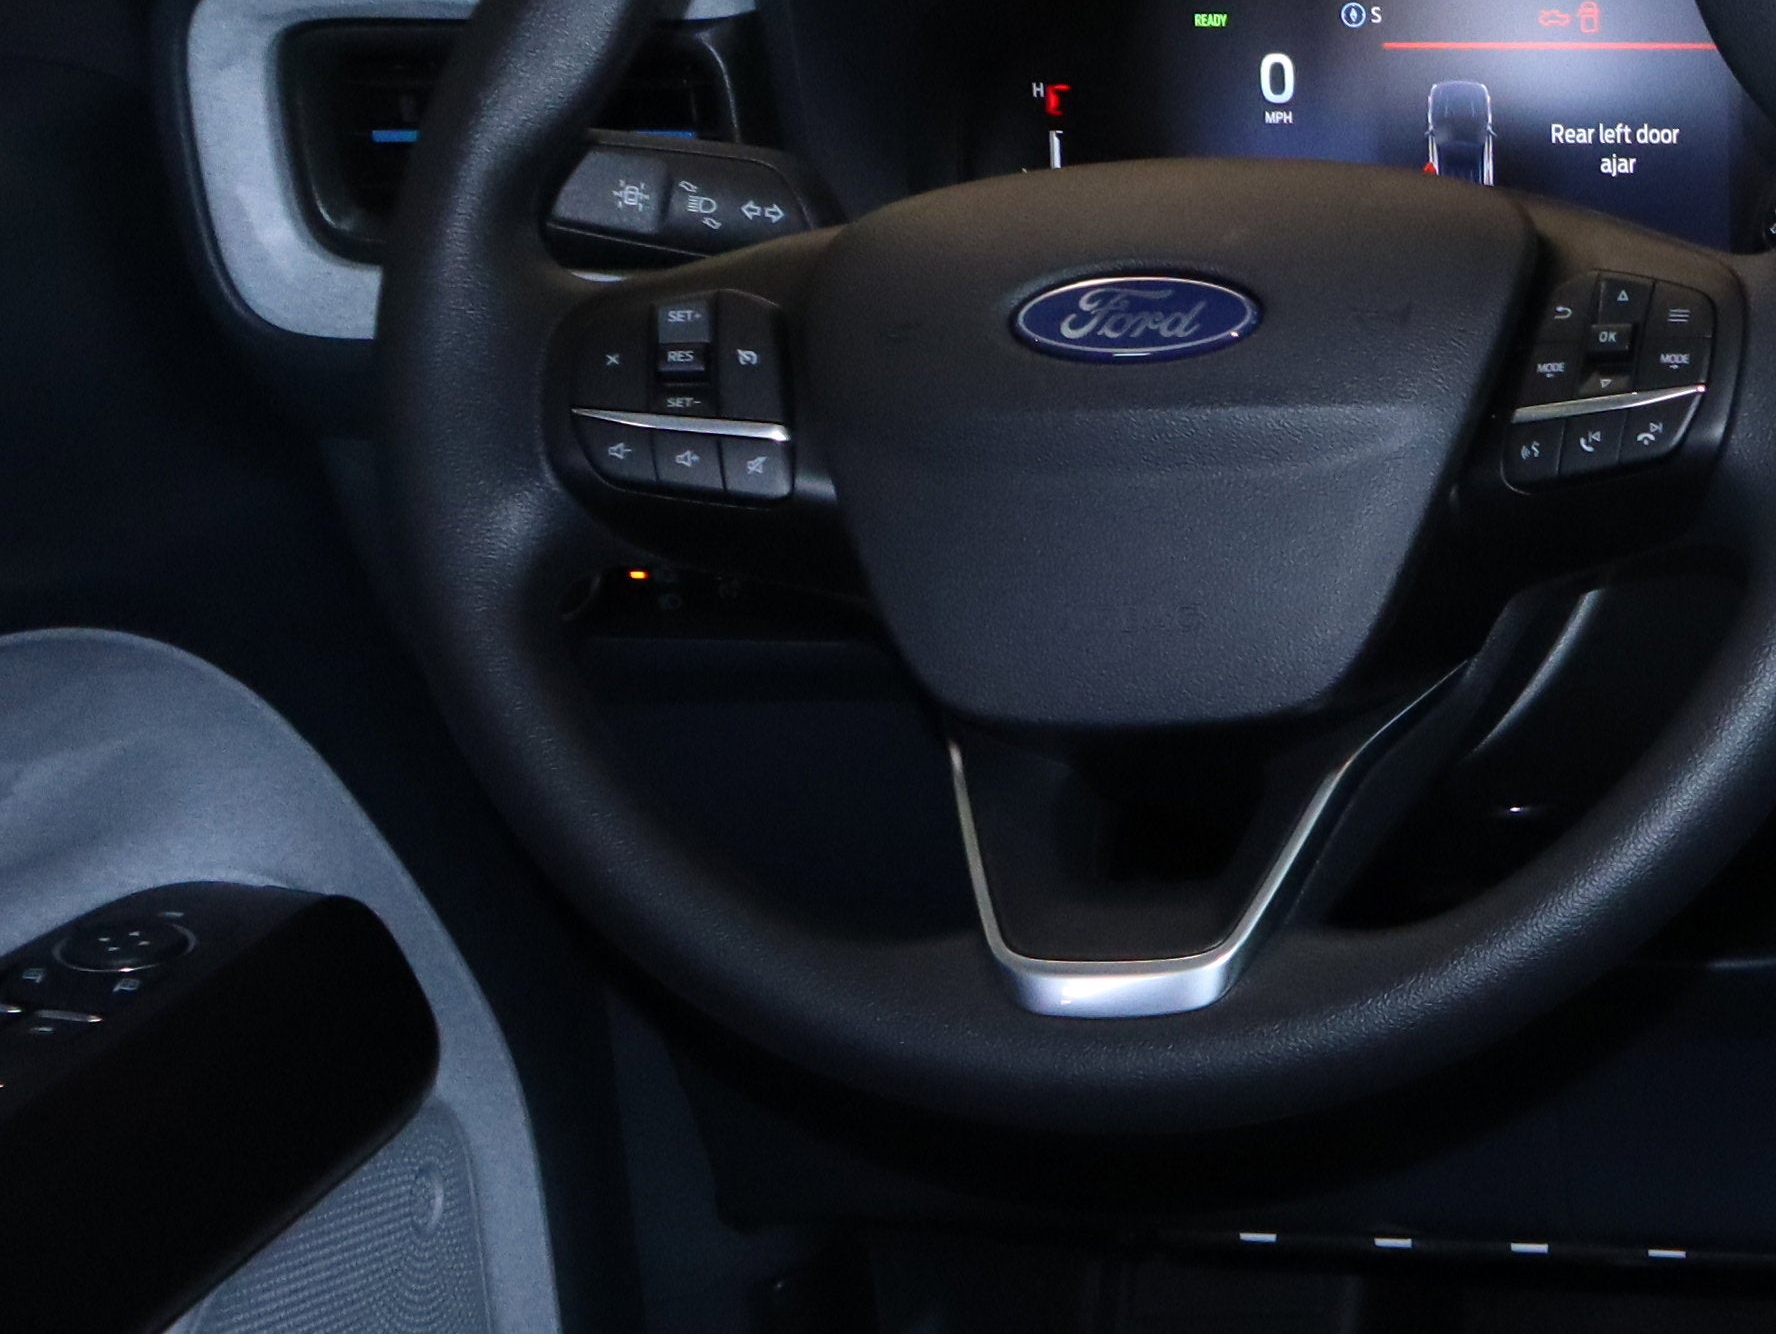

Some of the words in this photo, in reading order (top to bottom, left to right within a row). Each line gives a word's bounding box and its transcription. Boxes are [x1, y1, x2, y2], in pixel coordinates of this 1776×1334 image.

[1194, 13, 1228, 27] READY
[1370, 6, 1382, 24] S
[1260, 53, 1295, 104] 0
[1032, 82, 1044, 98] H
[1264, 111, 1294, 124] MPH
[1551, 123, 1595, 144] Rear
[1598, 122, 1632, 144] left
[1636, 123, 1680, 144] door
[1600, 153, 1637, 177] ajar
[1059, 288, 1202, 341] Ford
[1599, 331, 1617, 343] OK
[667, 350, 694, 362] RES
[1660, 353, 1690, 365] MODE
[1536, 362, 1565, 373] MODE
